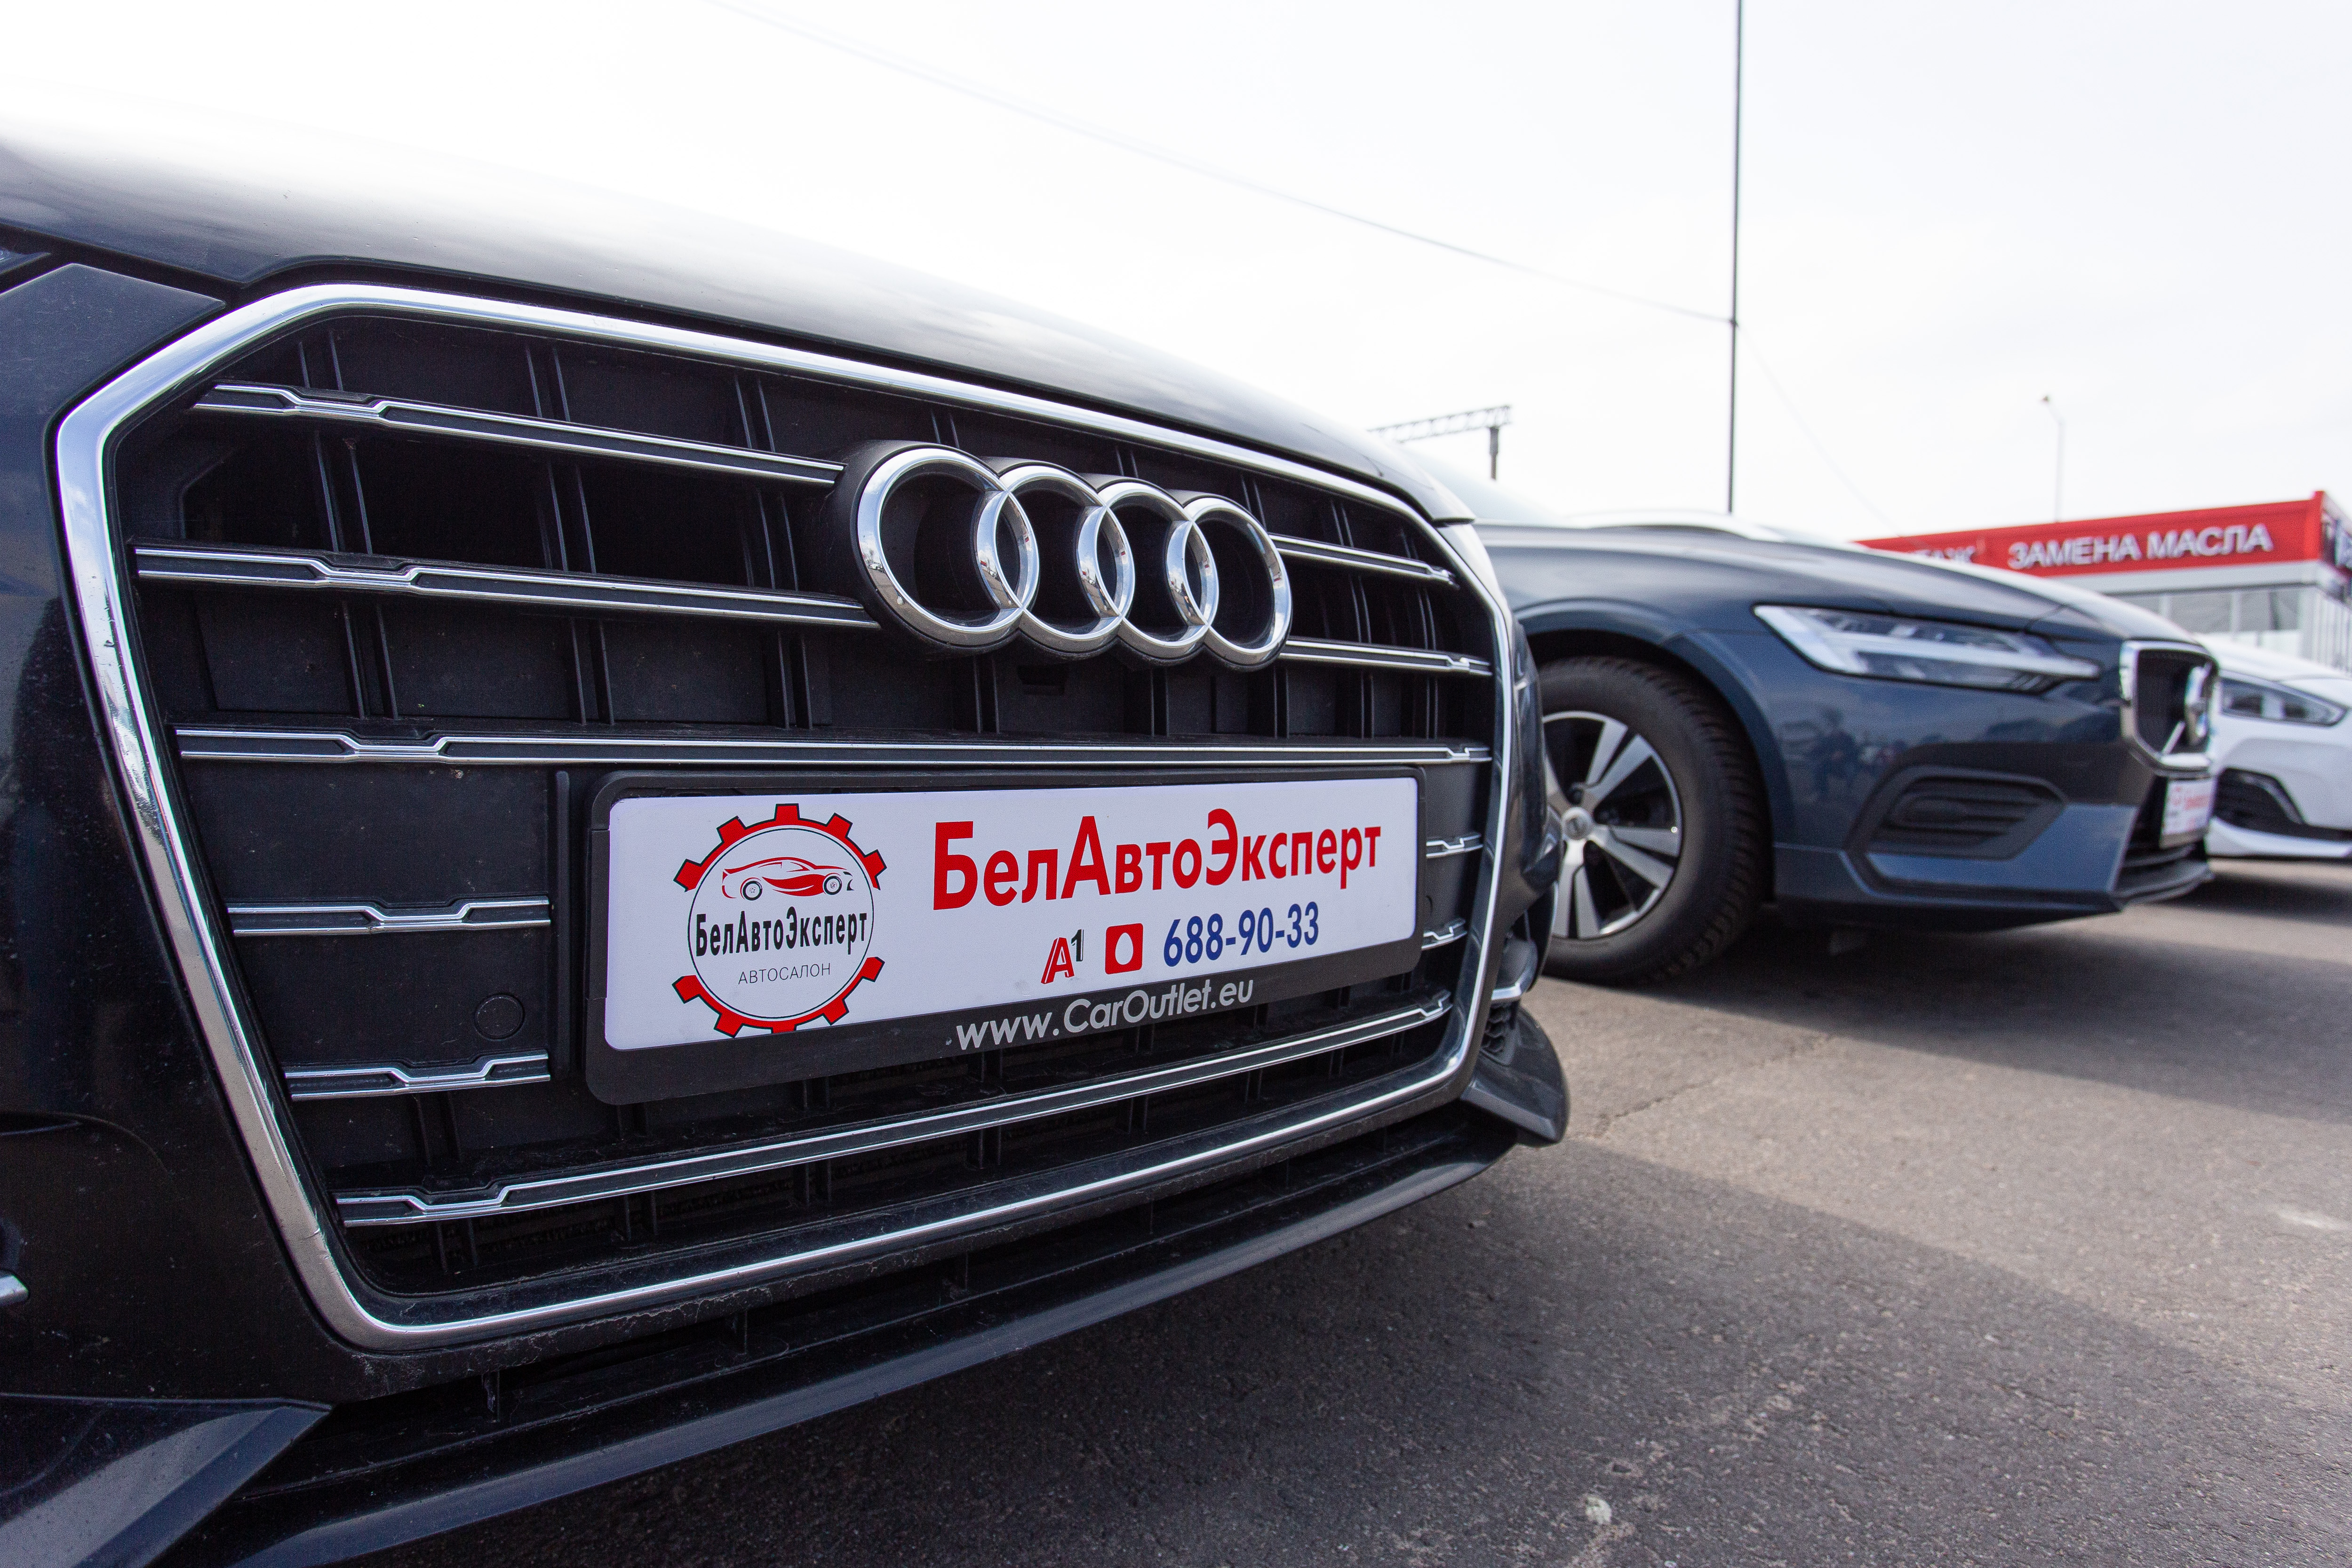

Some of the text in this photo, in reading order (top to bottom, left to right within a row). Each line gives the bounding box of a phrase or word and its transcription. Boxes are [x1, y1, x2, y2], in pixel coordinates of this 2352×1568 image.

[2008, 533, 2142, 570] ЗАМЕНА
[2147, 523, 2274, 560] МАСЛА
[933, 808, 1381, 911] БелАвтоЭксперт
[696, 906, 867, 957] БелАвтоЭксперт
[1163, 901, 1319, 968] 688-90-33
[738, 963, 831, 985] АВТОСАЛОН
[956, 979, 1253, 1050] www.CarOutlet.eu
